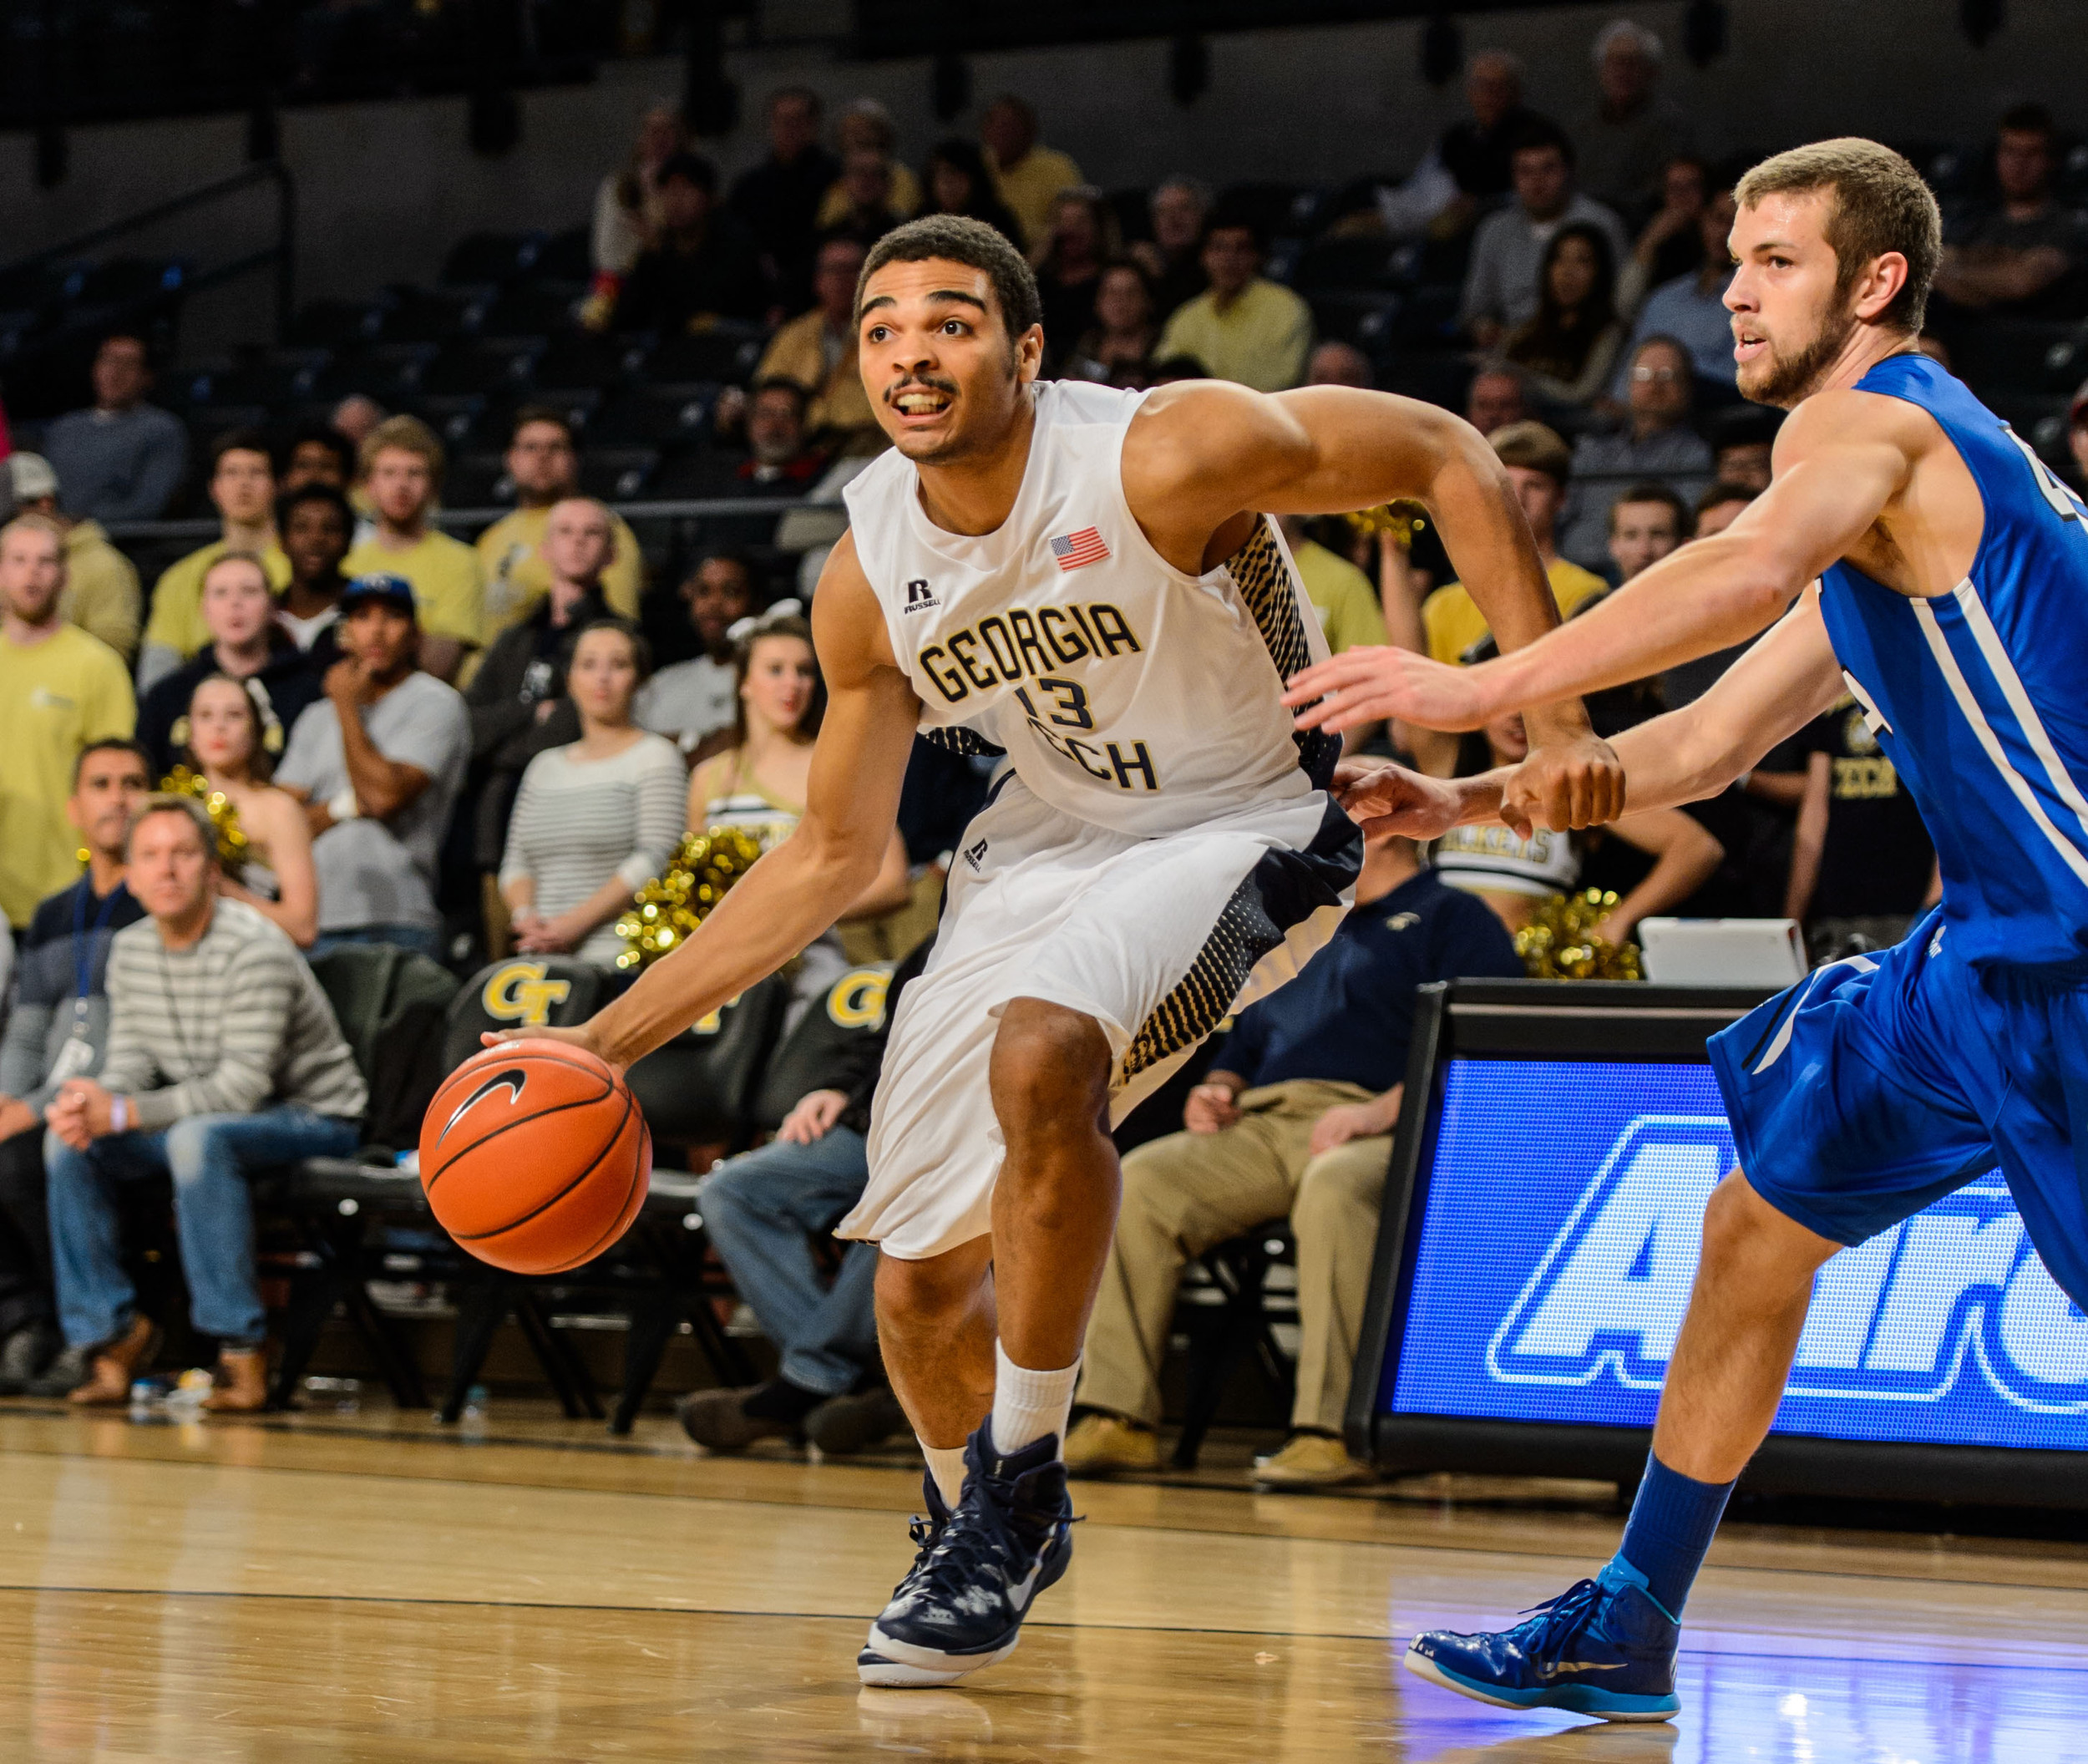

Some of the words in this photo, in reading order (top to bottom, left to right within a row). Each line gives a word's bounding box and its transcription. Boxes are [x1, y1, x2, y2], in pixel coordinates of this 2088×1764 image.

[904, 598, 941, 615] RUSSELL
[918, 601, 1143, 703] GEORGIA
[1012, 675, 1097, 732] 13
[1026, 716, 1161, 792] ECH
[482, 961, 572, 1028] GT
